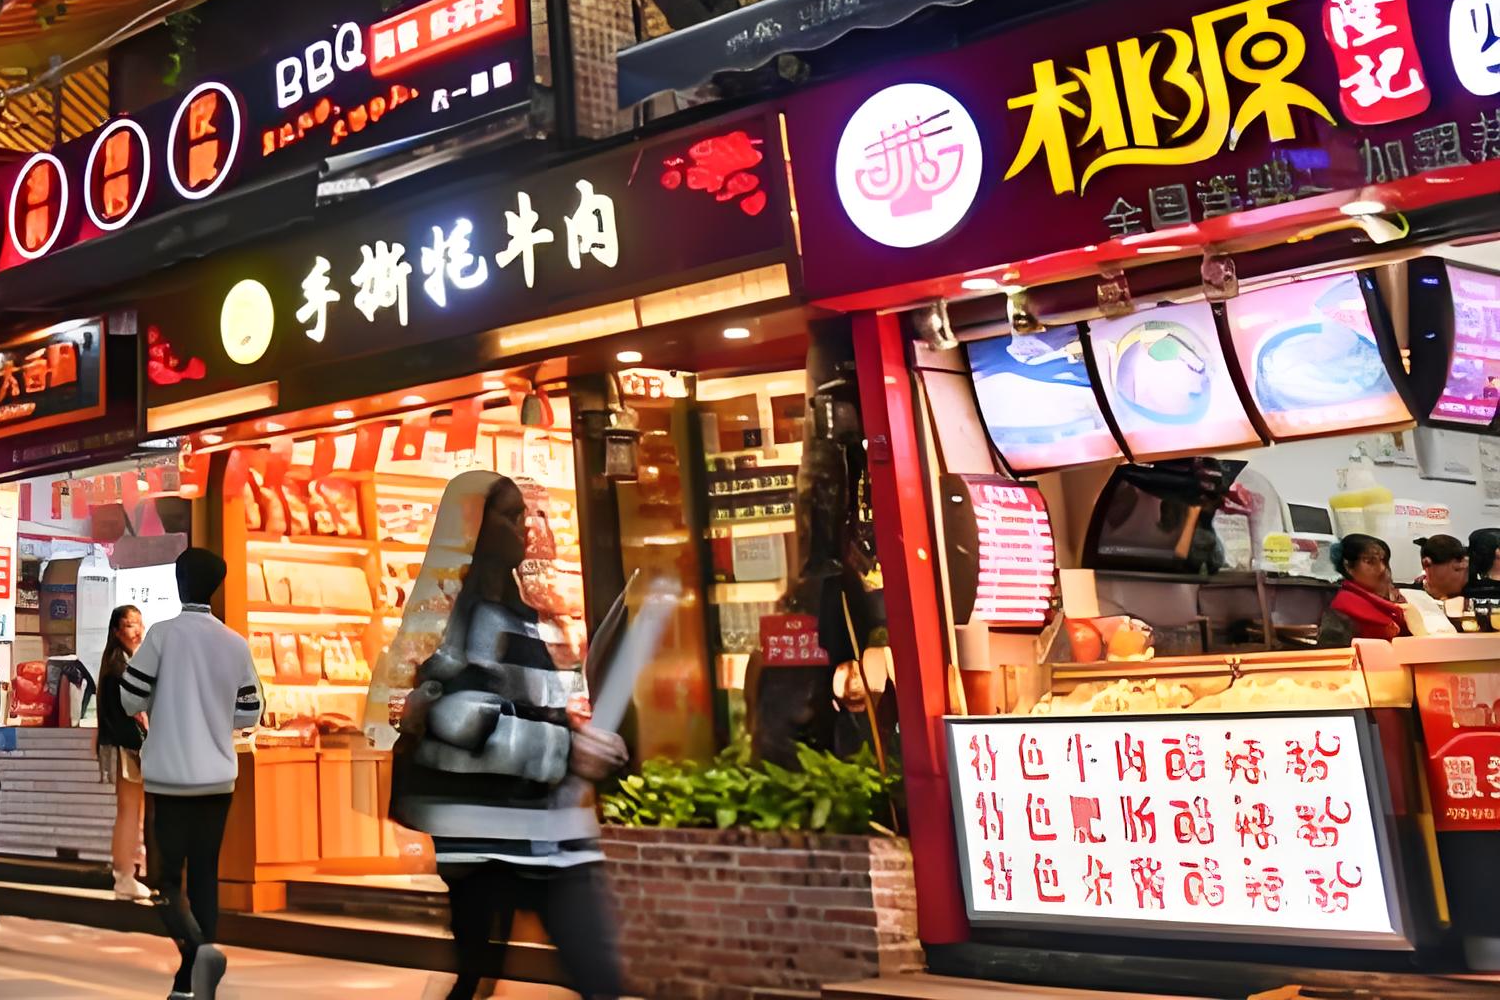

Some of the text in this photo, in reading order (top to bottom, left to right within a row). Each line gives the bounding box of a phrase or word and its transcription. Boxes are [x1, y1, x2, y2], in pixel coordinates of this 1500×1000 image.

[276, 21, 366, 109] BBQ
[295, 178, 619, 343] 手撕牦牛肉
